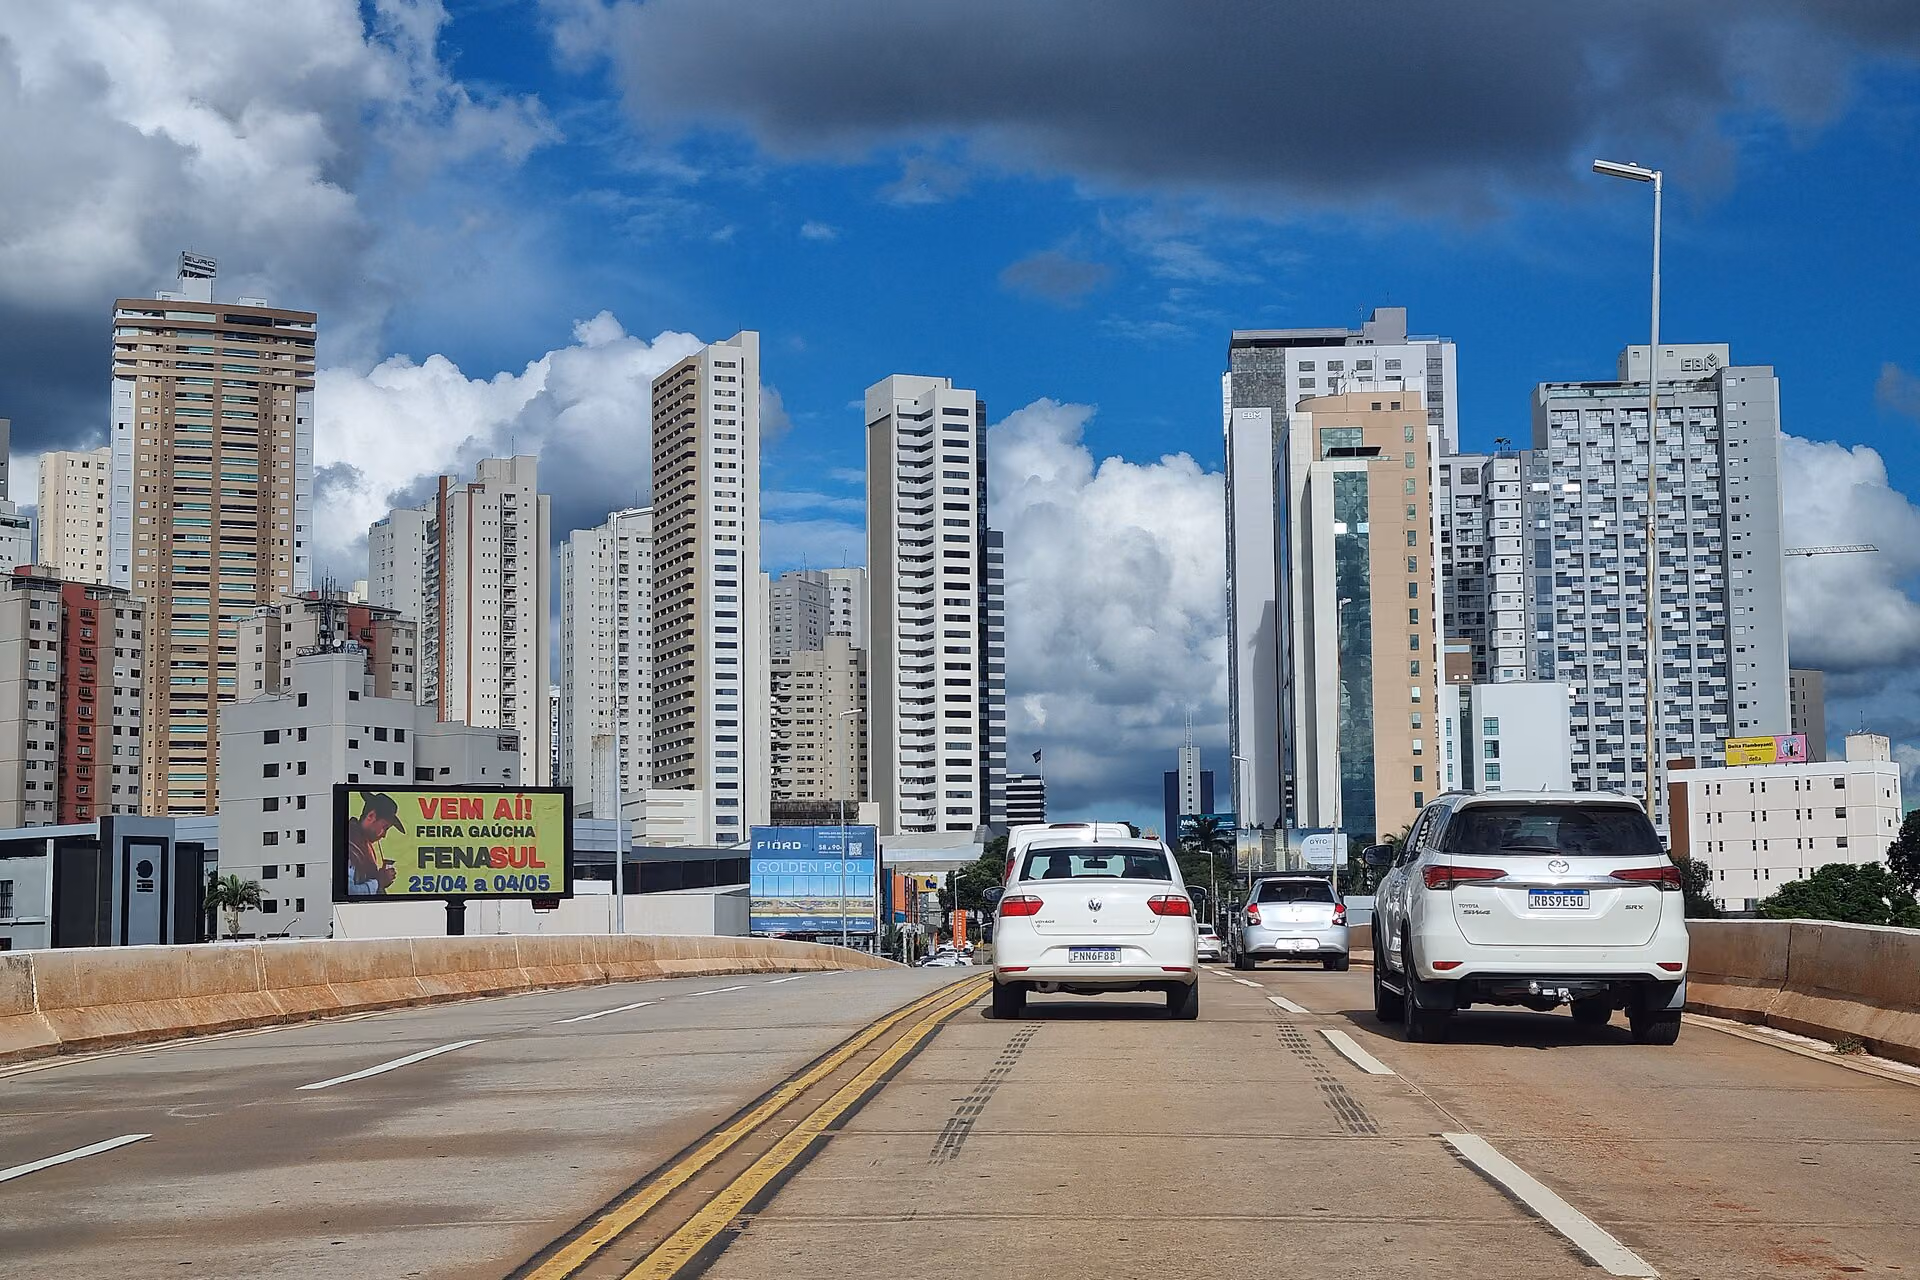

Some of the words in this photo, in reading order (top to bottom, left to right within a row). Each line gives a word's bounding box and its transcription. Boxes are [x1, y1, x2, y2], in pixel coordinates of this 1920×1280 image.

[1680, 356, 1720, 371] EBM
[1242, 410, 1262, 419] EBM
[418, 797, 484, 820] VEM
[493, 793, 533, 820] AÍ!
[416, 825, 464, 838] FEIRA
[468, 823, 536, 838] GAÚCHA
[417, 846, 546, 869] FENASUL
[756, 861, 818, 873] GOLDEN
[824, 861, 864, 873] POOL
[408, 875, 467, 893] 25/04
[474, 879, 488, 892] a
[493, 874, 551, 892] 04/05
[1534, 895, 1584, 907] RBS9E50
[1073, 951, 1116, 961] FNN6F88
